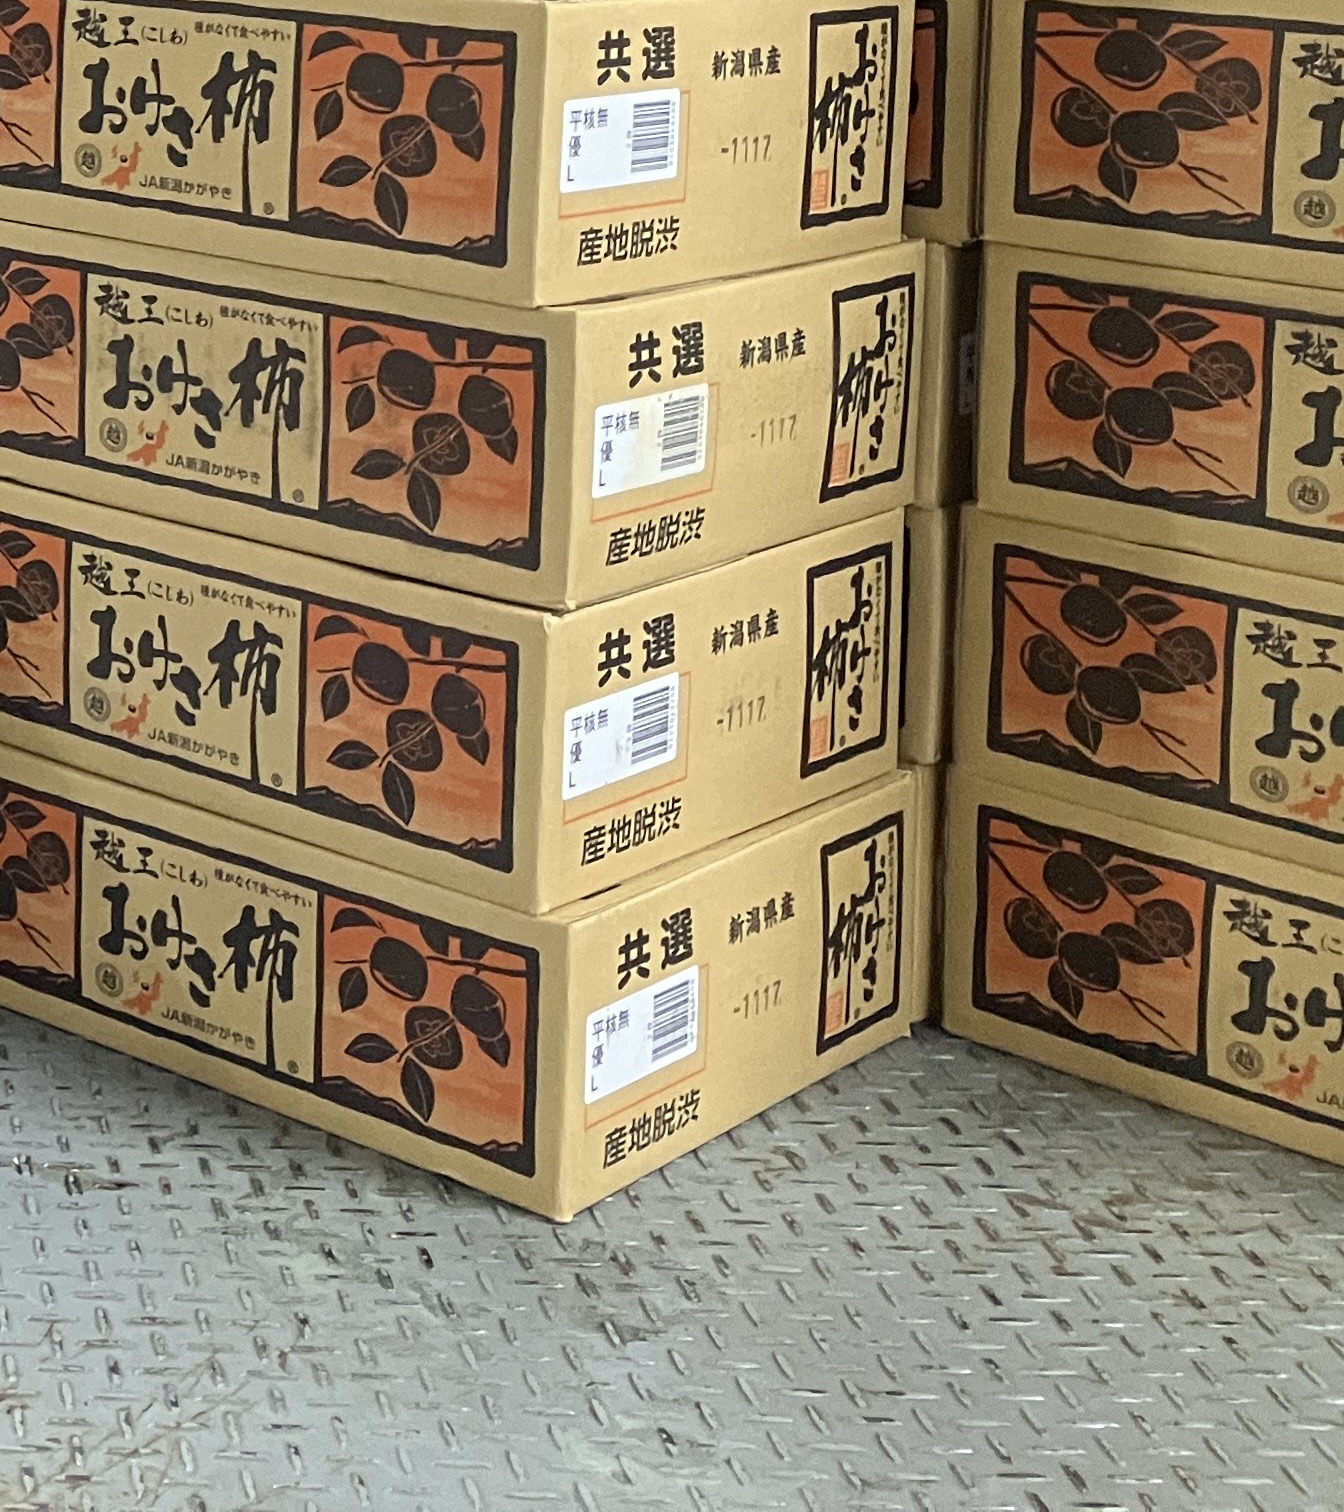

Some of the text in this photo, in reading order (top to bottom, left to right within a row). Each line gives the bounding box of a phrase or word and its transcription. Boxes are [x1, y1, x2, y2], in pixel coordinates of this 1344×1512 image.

[71, 7, 187, 48] 越王(こしわ)
[597, 26, 677, 86] 共選
[711, 45, 782, 81] 新潟県産
[78, 49, 277, 215] おけさ柿
[568, 134, 582, 158] 優
[138, 174, 231, 200] JA新潟かがやき
[566, 163, 575, 183] L
[577, 215, 681, 268] 産地脱渋
[94, 283, 213, 327] 越王(こしわ)
[628, 321, 705, 388] 共選
[738, 328, 807, 370] 新潟県産
[103, 333, 306, 502] おけさ柿
[166, 453, 261, 485] JA新潟かがやき
[600, 439, 614, 464] 優
[598, 469, 607, 488] L
[606, 507, 706, 567] 産地脱渋
[77, 553, 193, 605] 越王(こしわ)
[598, 613, 677, 687] 共選
[711, 607, 780, 656] 新潟県産
[86, 605, 283, 784] おけさ柿
[147, 727, 239, 766] JA新潟かがやき
[568, 739, 583, 764] 優
[568, 767, 576, 788] L
[581, 795, 682, 867] 産地脱渋
[89, 829, 207, 888] 越王(こしわ)
[728, 891, 796, 945] 新潟県産
[617, 907, 694, 990] 共選
[98, 881, 299, 1070] おけさ柿
[161, 1006, 255, 1050] JA新潟かがやき
[591, 1043, 604, 1068] 優
[591, 1074, 599, 1093] L
[602, 1089, 701, 1170] 産地脱渋
